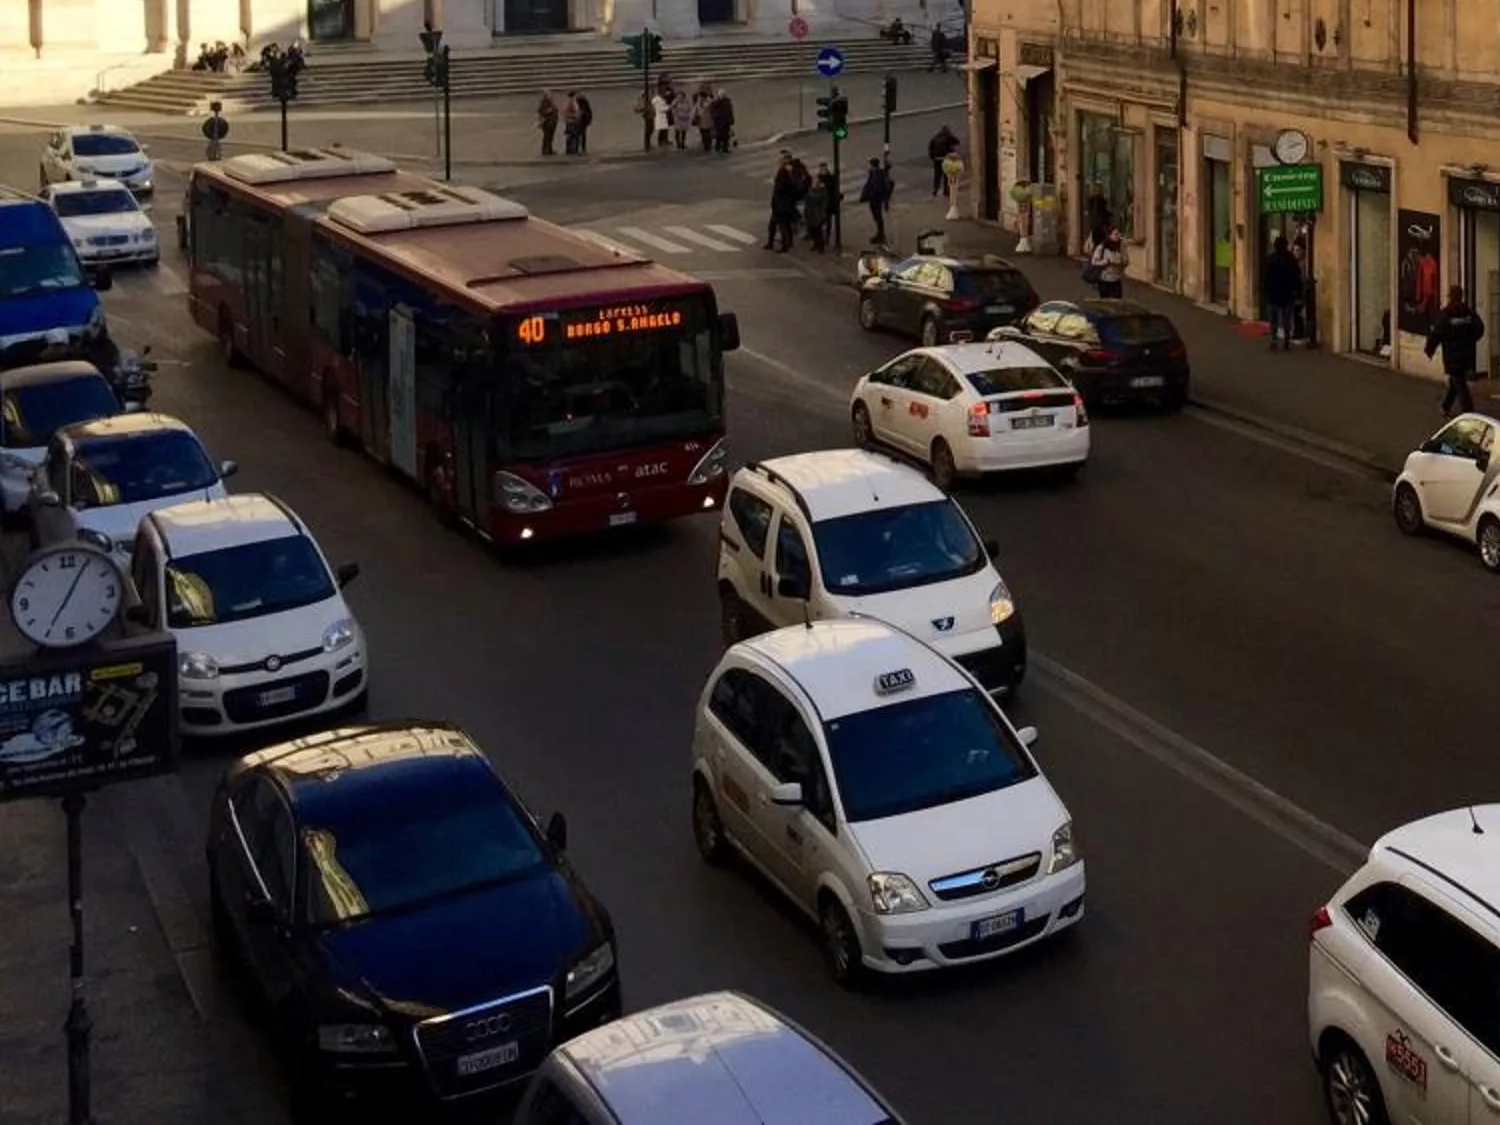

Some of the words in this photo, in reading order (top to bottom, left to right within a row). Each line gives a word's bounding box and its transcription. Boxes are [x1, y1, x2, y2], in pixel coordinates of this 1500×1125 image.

[518, 314, 546, 345] 40
[634, 461, 669, 478] atac
[881, 669, 912, 690] TAXI
